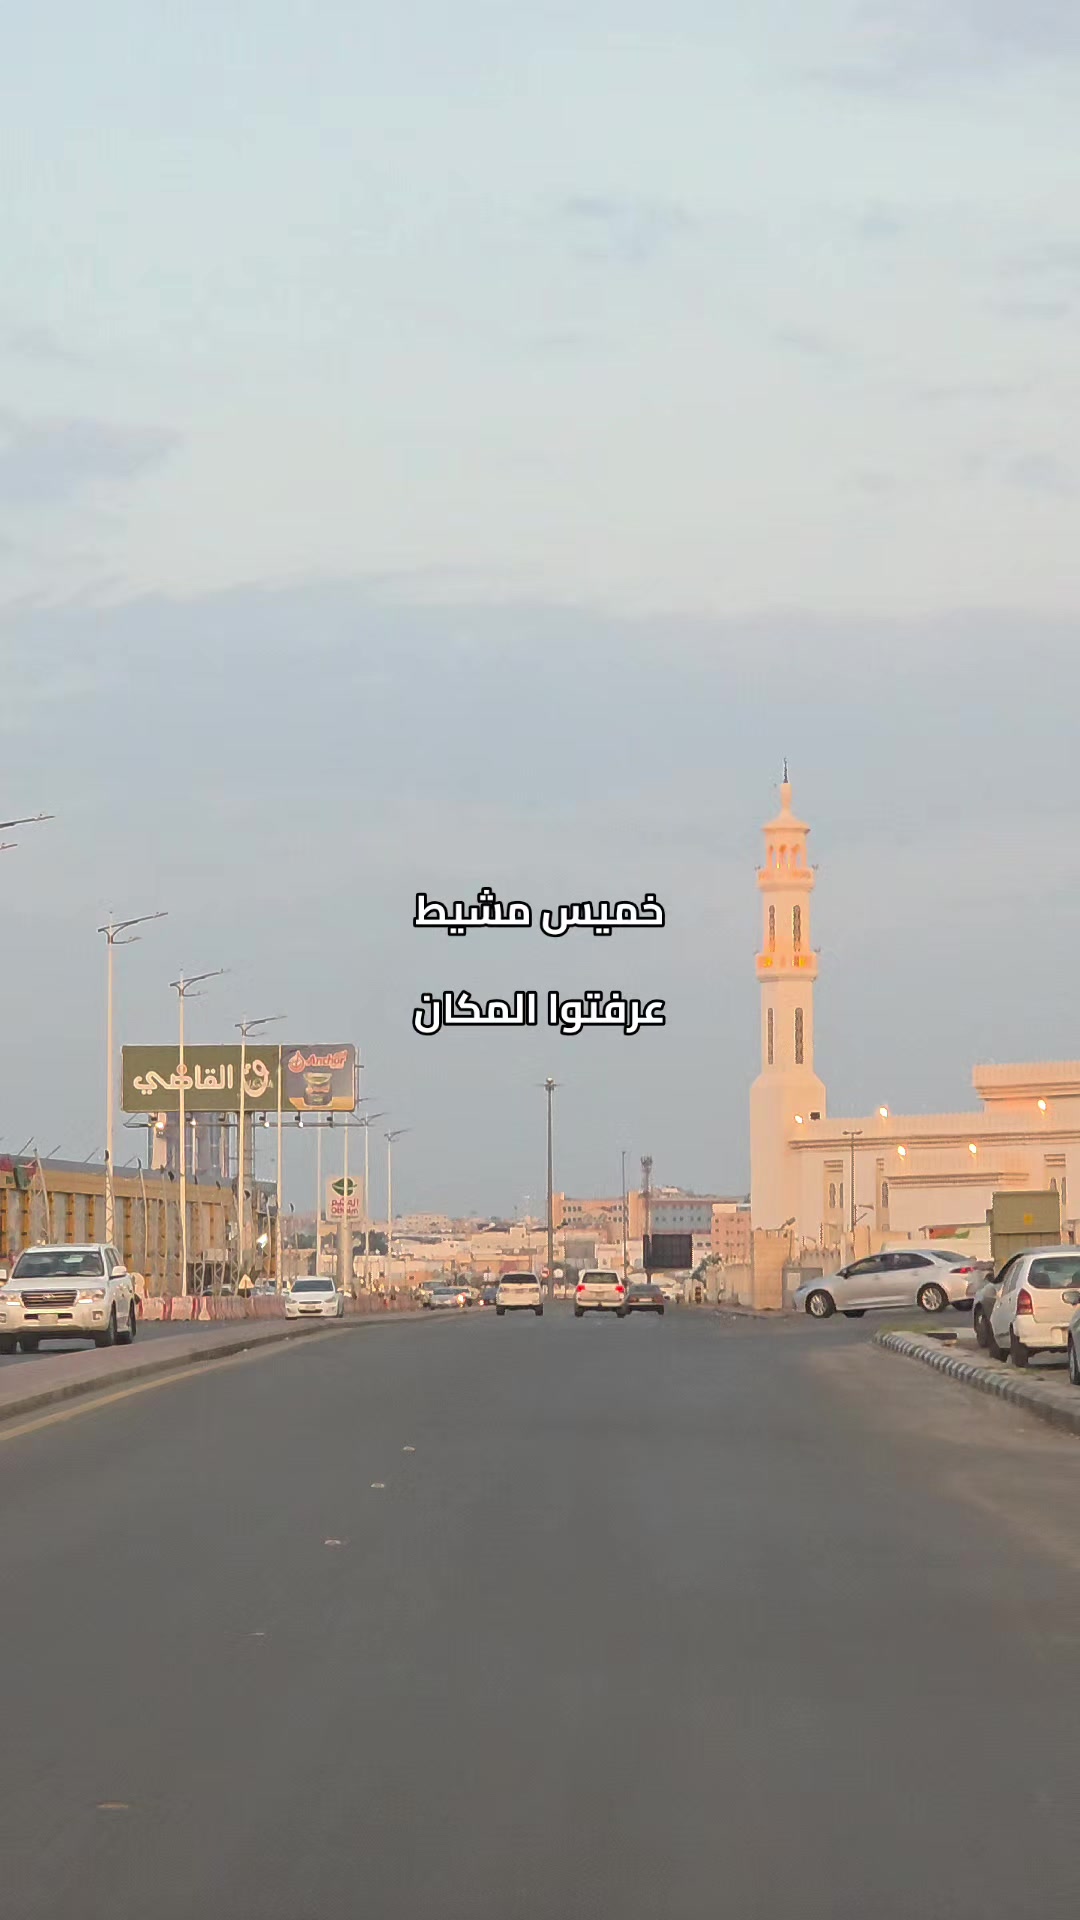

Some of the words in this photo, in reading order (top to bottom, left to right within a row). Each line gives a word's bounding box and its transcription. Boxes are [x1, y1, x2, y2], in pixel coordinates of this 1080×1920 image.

[305, 1052, 347, 1069] Anchor
[133, 1063, 234, 1095] القاضي
[331, 1206, 359, 1214] Othim
